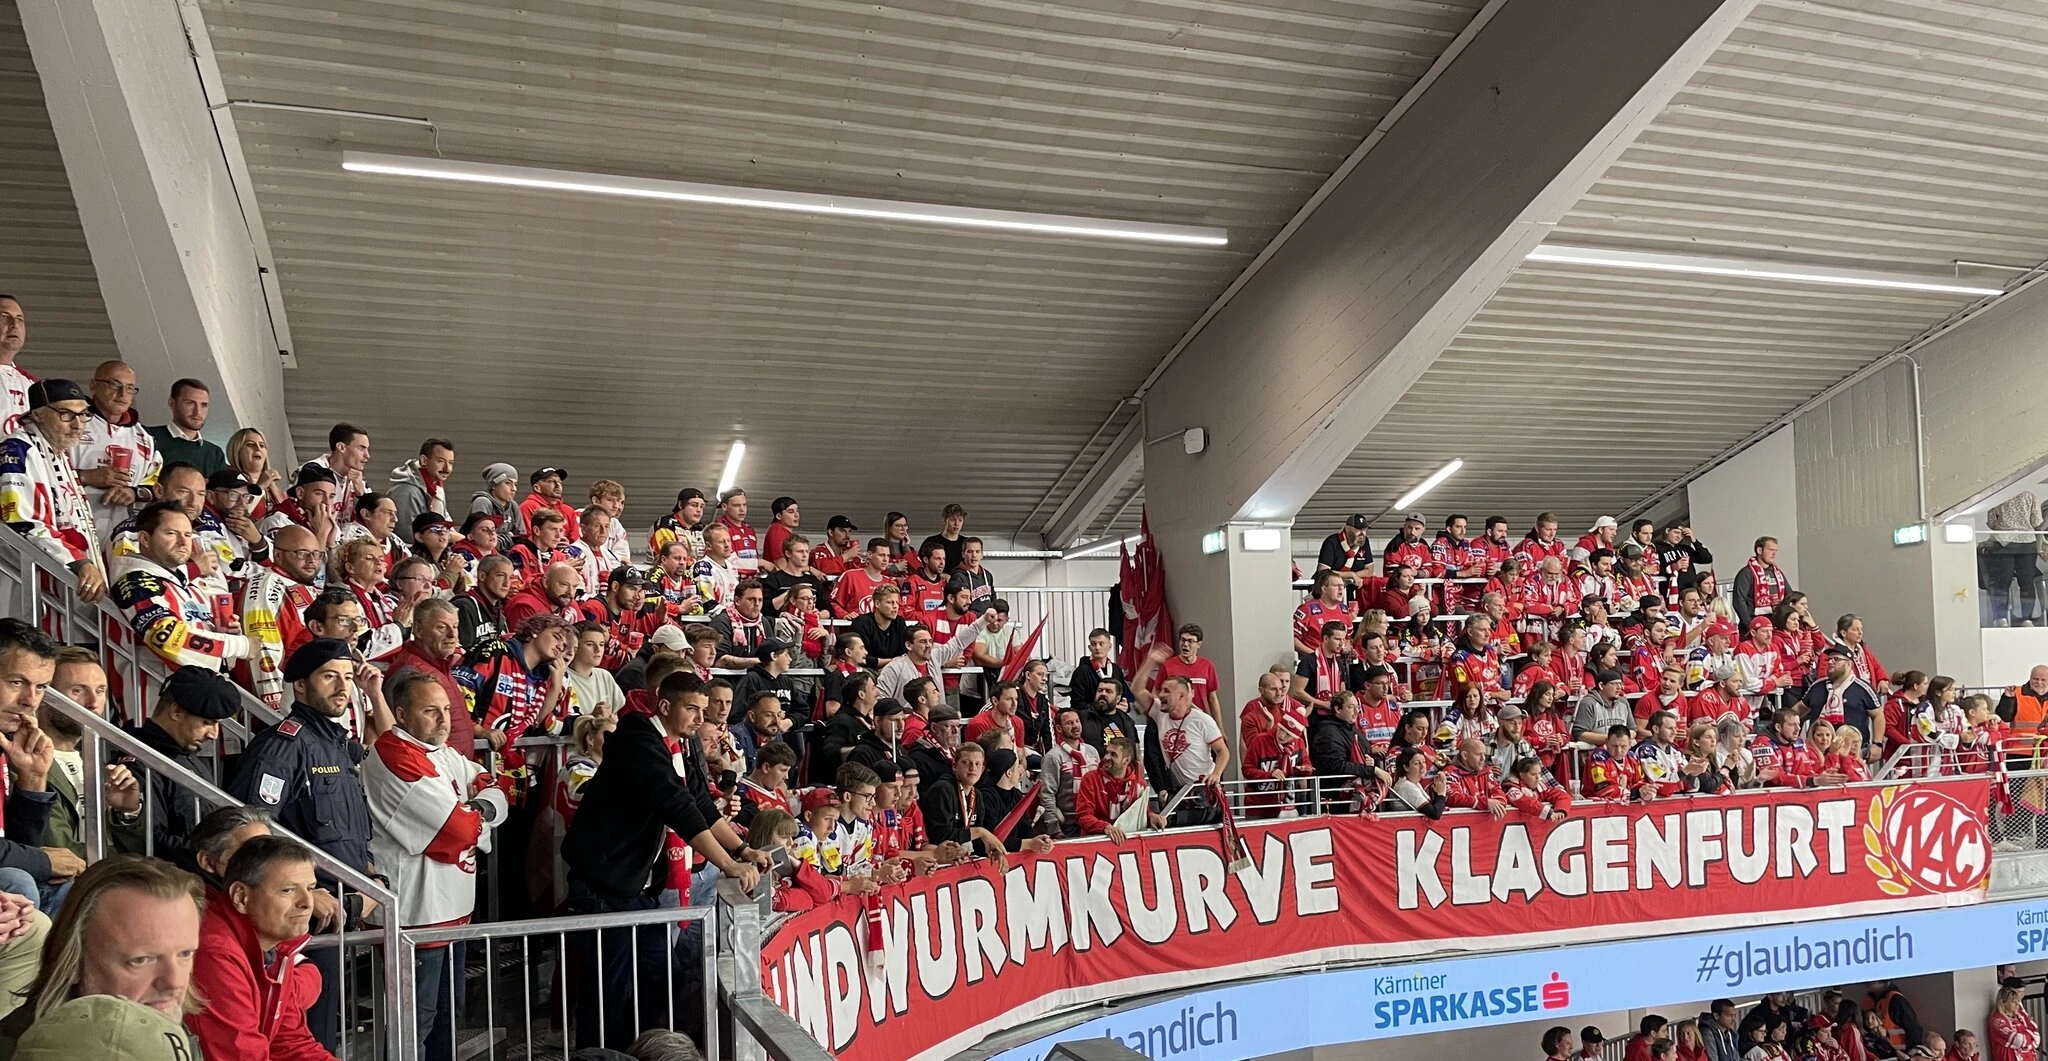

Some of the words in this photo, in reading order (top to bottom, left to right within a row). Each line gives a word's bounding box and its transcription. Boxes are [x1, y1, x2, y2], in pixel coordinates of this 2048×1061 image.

[311, 765, 340, 775] POLIZEI
[1261, 755, 1298, 773] NET
[1757, 756, 1771, 766] 28
[1396, 798, 1857, 910] KLAGENFURT
[1696, 925, 1914, 987] #glaubandich
[1374, 973, 1447, 996] Kärntner
[1374, 985, 1538, 1029] SPARKASSE
[1106, 1001, 1238, 1059] andich
